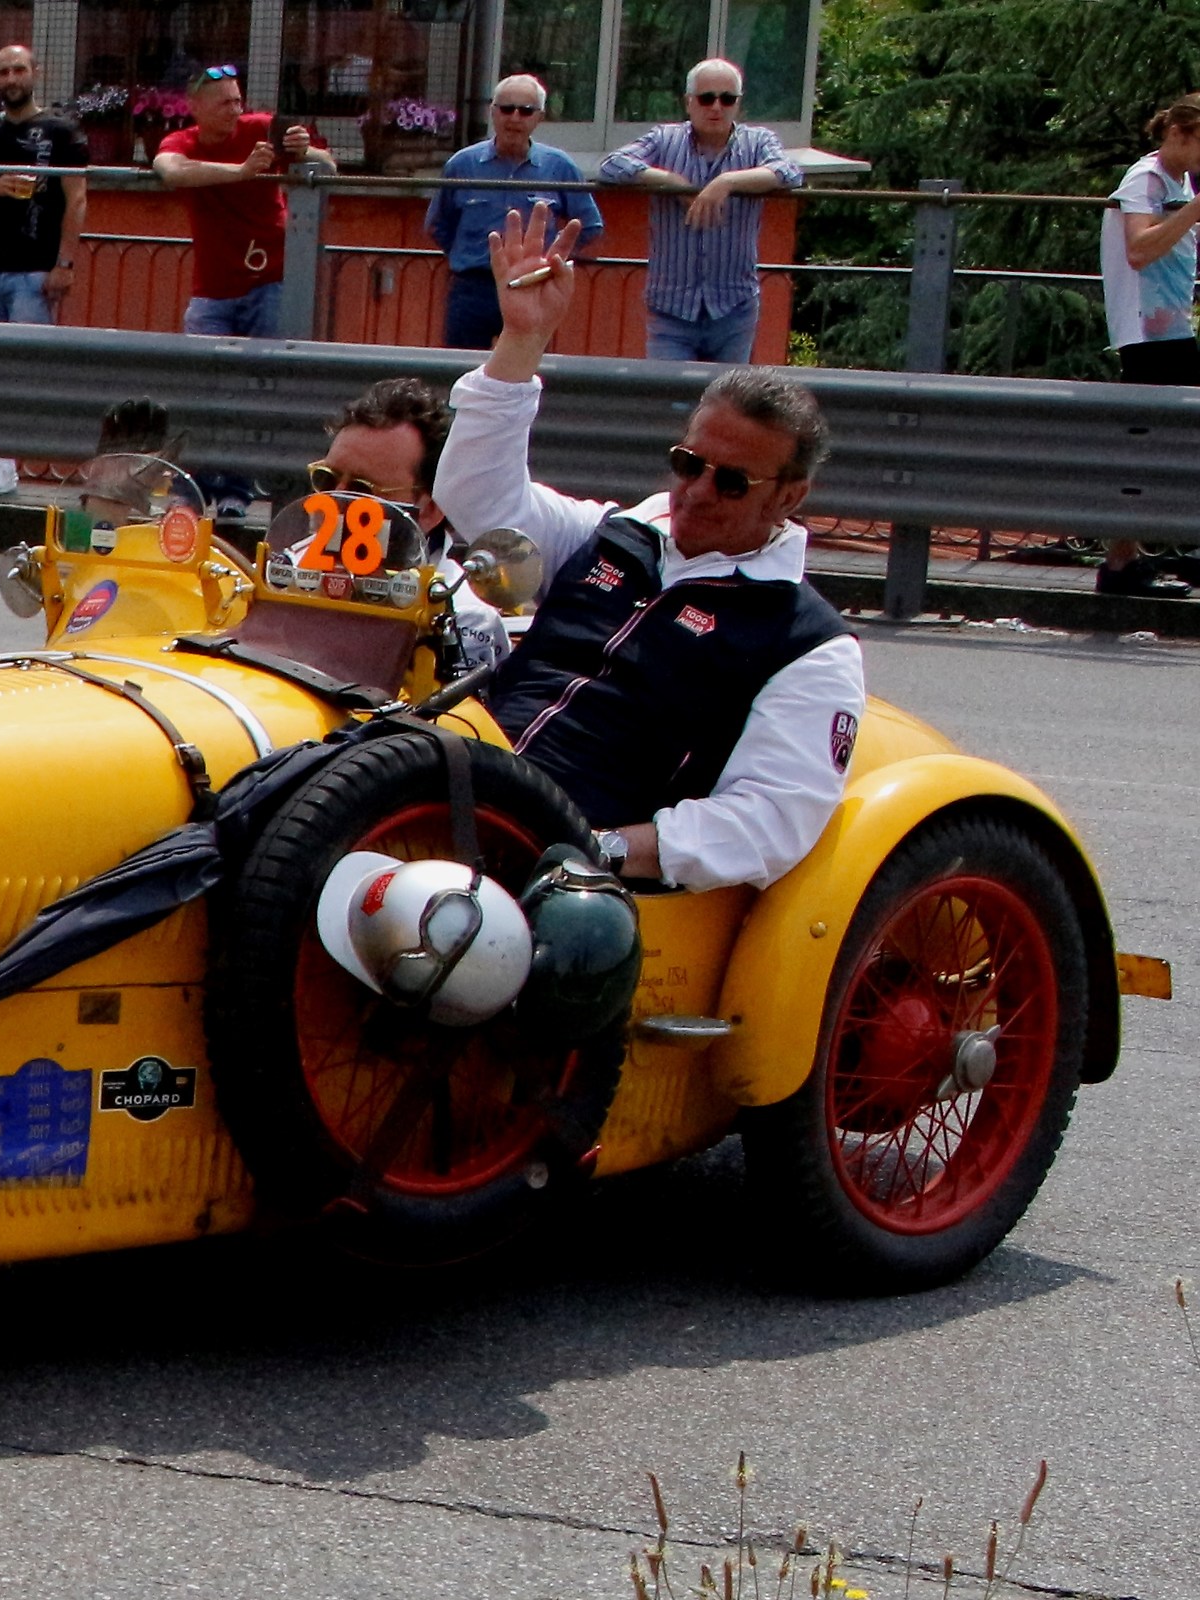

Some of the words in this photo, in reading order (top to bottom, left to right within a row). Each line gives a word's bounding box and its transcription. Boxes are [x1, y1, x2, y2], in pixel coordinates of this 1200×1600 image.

[244, 239, 267, 271] 6
[299, 493, 384, 575] 28
[686, 610, 708, 625] 1000
[114, 1093, 180, 1106] CHOPARD
